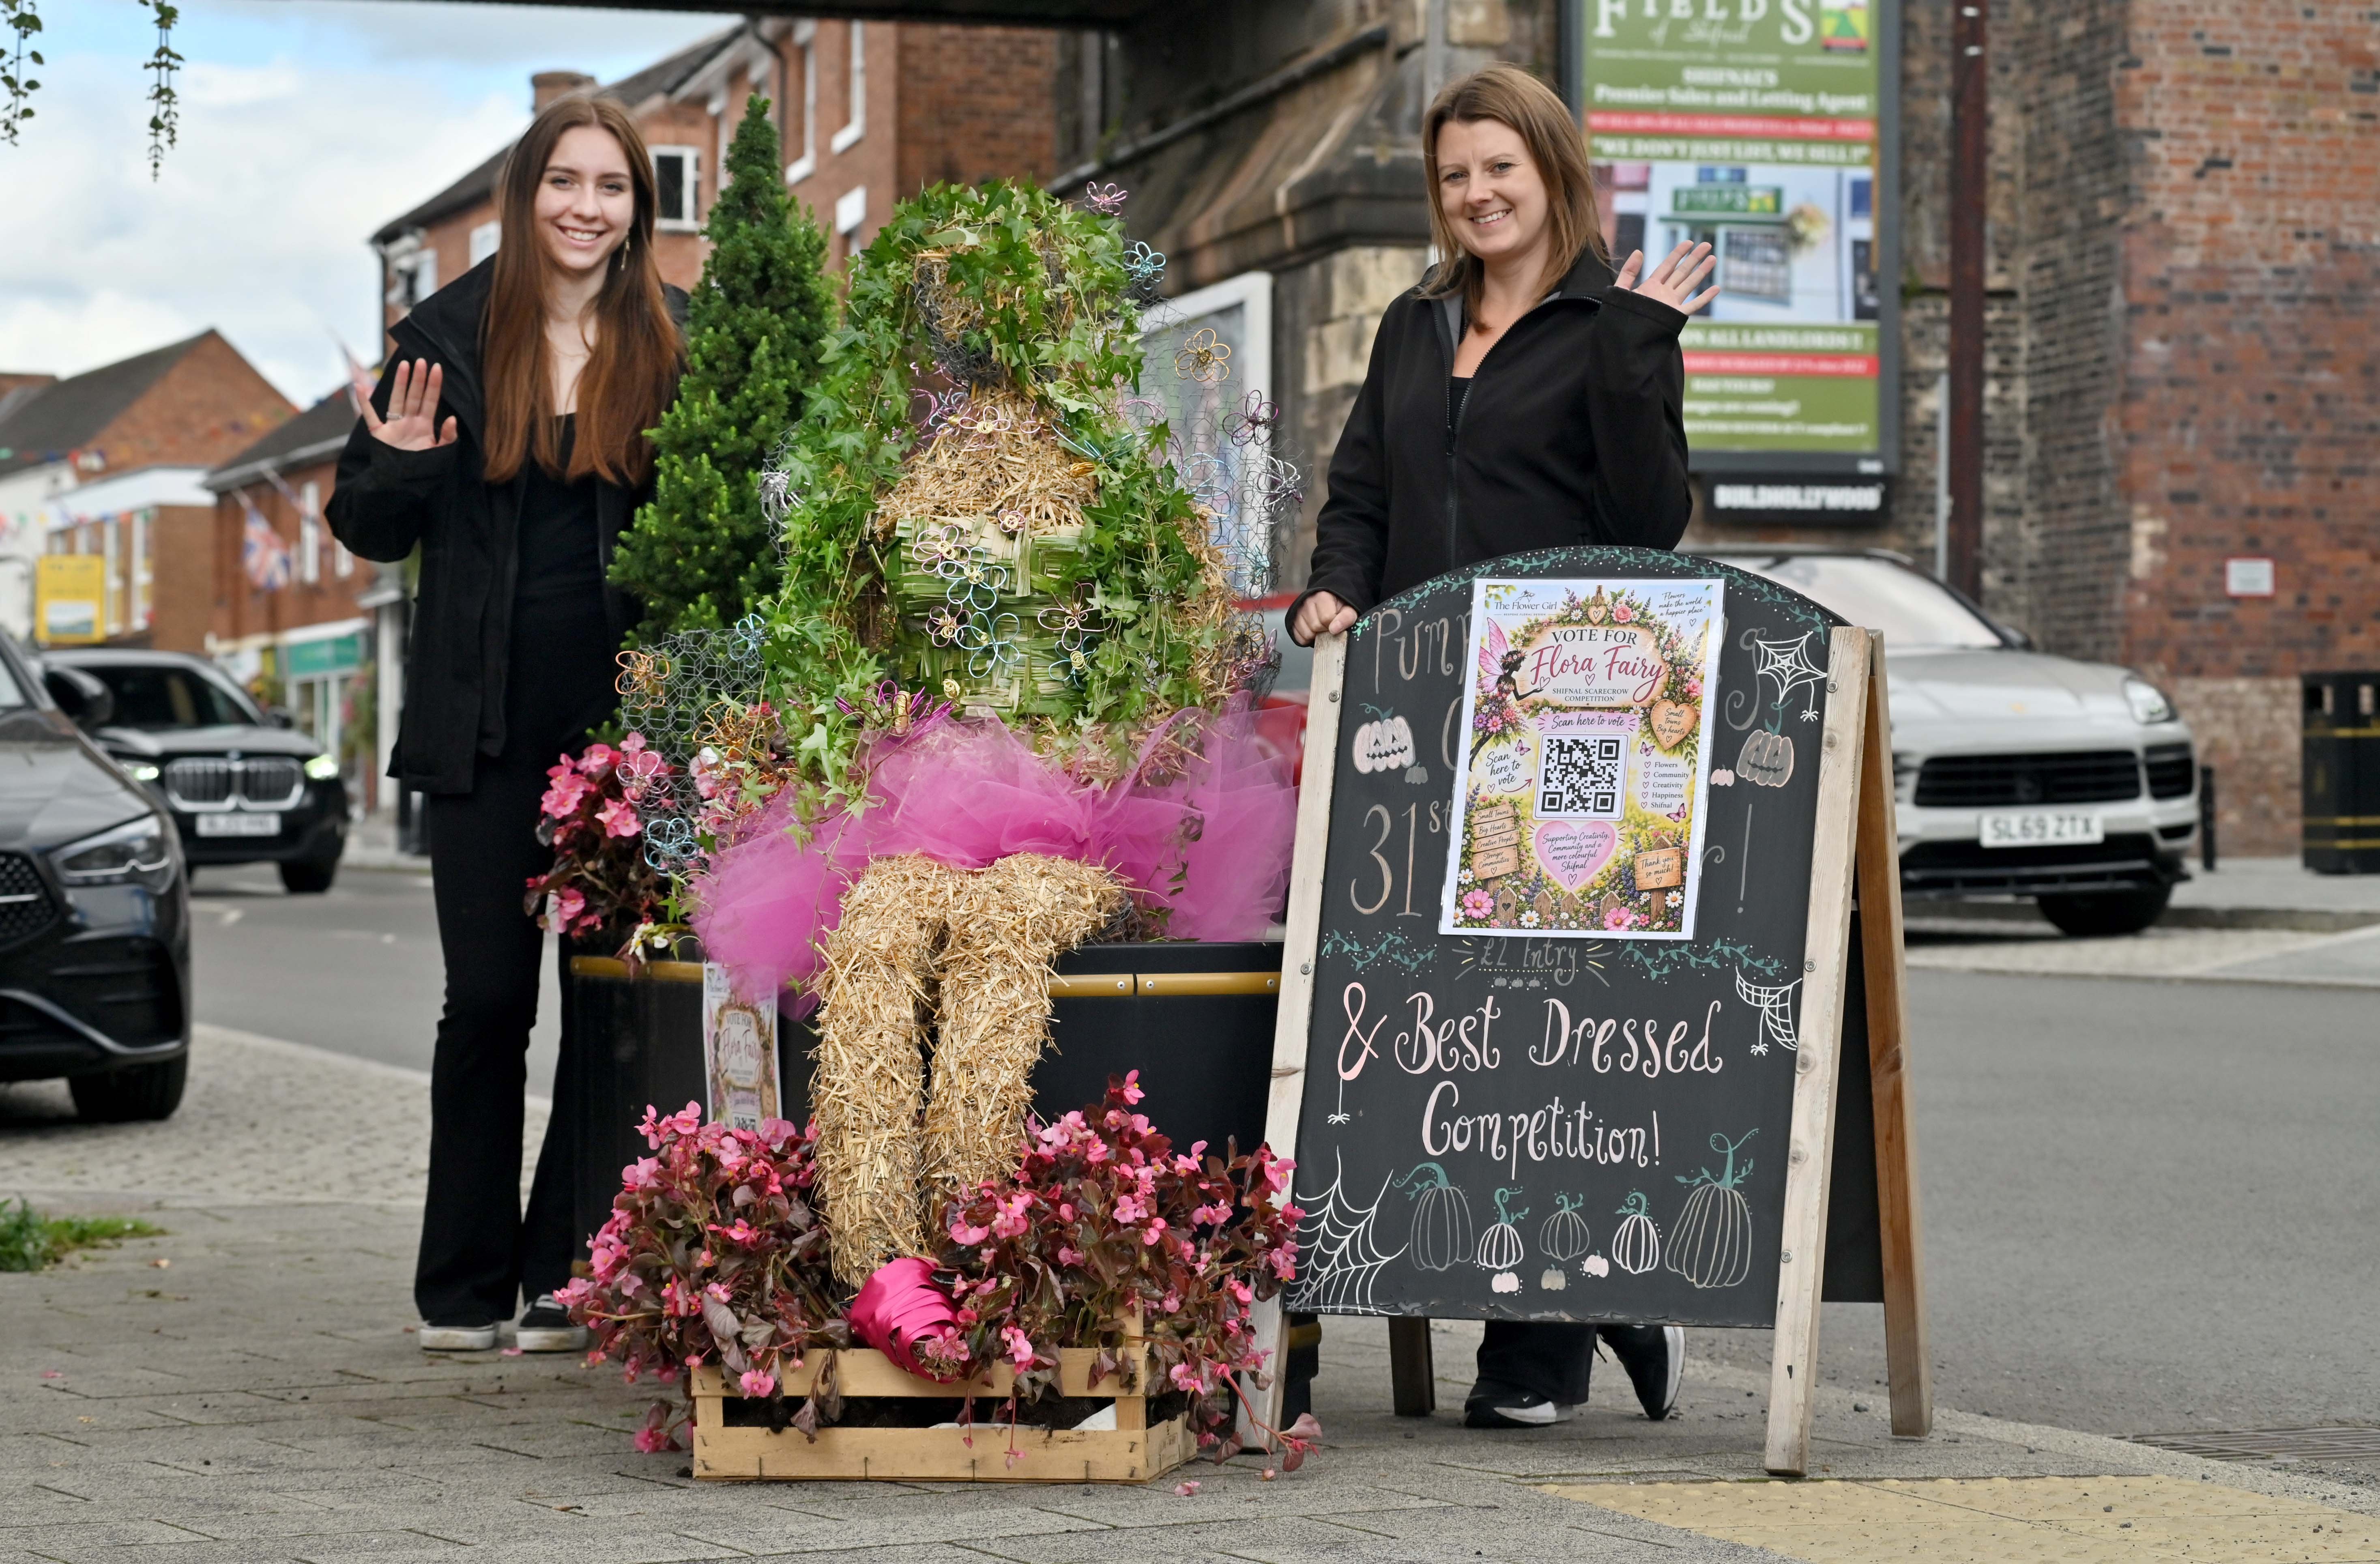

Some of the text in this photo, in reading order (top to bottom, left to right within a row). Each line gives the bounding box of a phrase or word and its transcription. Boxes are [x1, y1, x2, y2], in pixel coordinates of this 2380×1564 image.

[1595, 84, 1867, 114] Premier Sales and Letting Agent
[1708, 330, 1740, 348] ALL
[1743, 331, 1848, 350] LANDLORDS
[1495, 601, 1557, 610] The Flower Girl
[1685, 597, 1702, 605] world
[1666, 609, 1686, 617] happier
[1552, 629, 1637, 645] VOTE FOR
[1530, 644, 1597, 685] Flora
[1604, 645, 1666, 703] Fairy
[1665, 708, 1684, 718] Small
[1551, 713, 1625, 729] Scan here to vote
[1665, 717, 1681, 725] towns
[1656, 724, 1685, 735] Big hearts
[1486, 751, 1511, 767] Scan
[1490, 759, 1522, 776] here to
[1499, 772, 1516, 785] vote
[1478, 809, 1509, 821] Small Towns
[1479, 823, 1506, 836] Big Hearts
[1992, 814, 2092, 840] SL69 ZTX
[1477, 834, 1514, 849] Creative People
[1542, 831, 1610, 844] Supporting Creativity,
[1549, 843, 1583, 853] Community
[1585, 840, 1596, 849] and
[1483, 851, 1504, 861] Stronger
[1569, 849, 1597, 860] colourful
[1478, 857, 1509, 869] Communities
[1561, 860, 1587, 872] Shifnal
[1640, 856, 1674, 870] Thank you
[1654, 864, 1673, 875] much!
[1523, 938, 1577, 986] Entry
[726, 1013, 752, 1027] VOTE FOR
[1338, 983, 1723, 1080] & Best Dressed
[1422, 1081, 1660, 1179] Competition!
